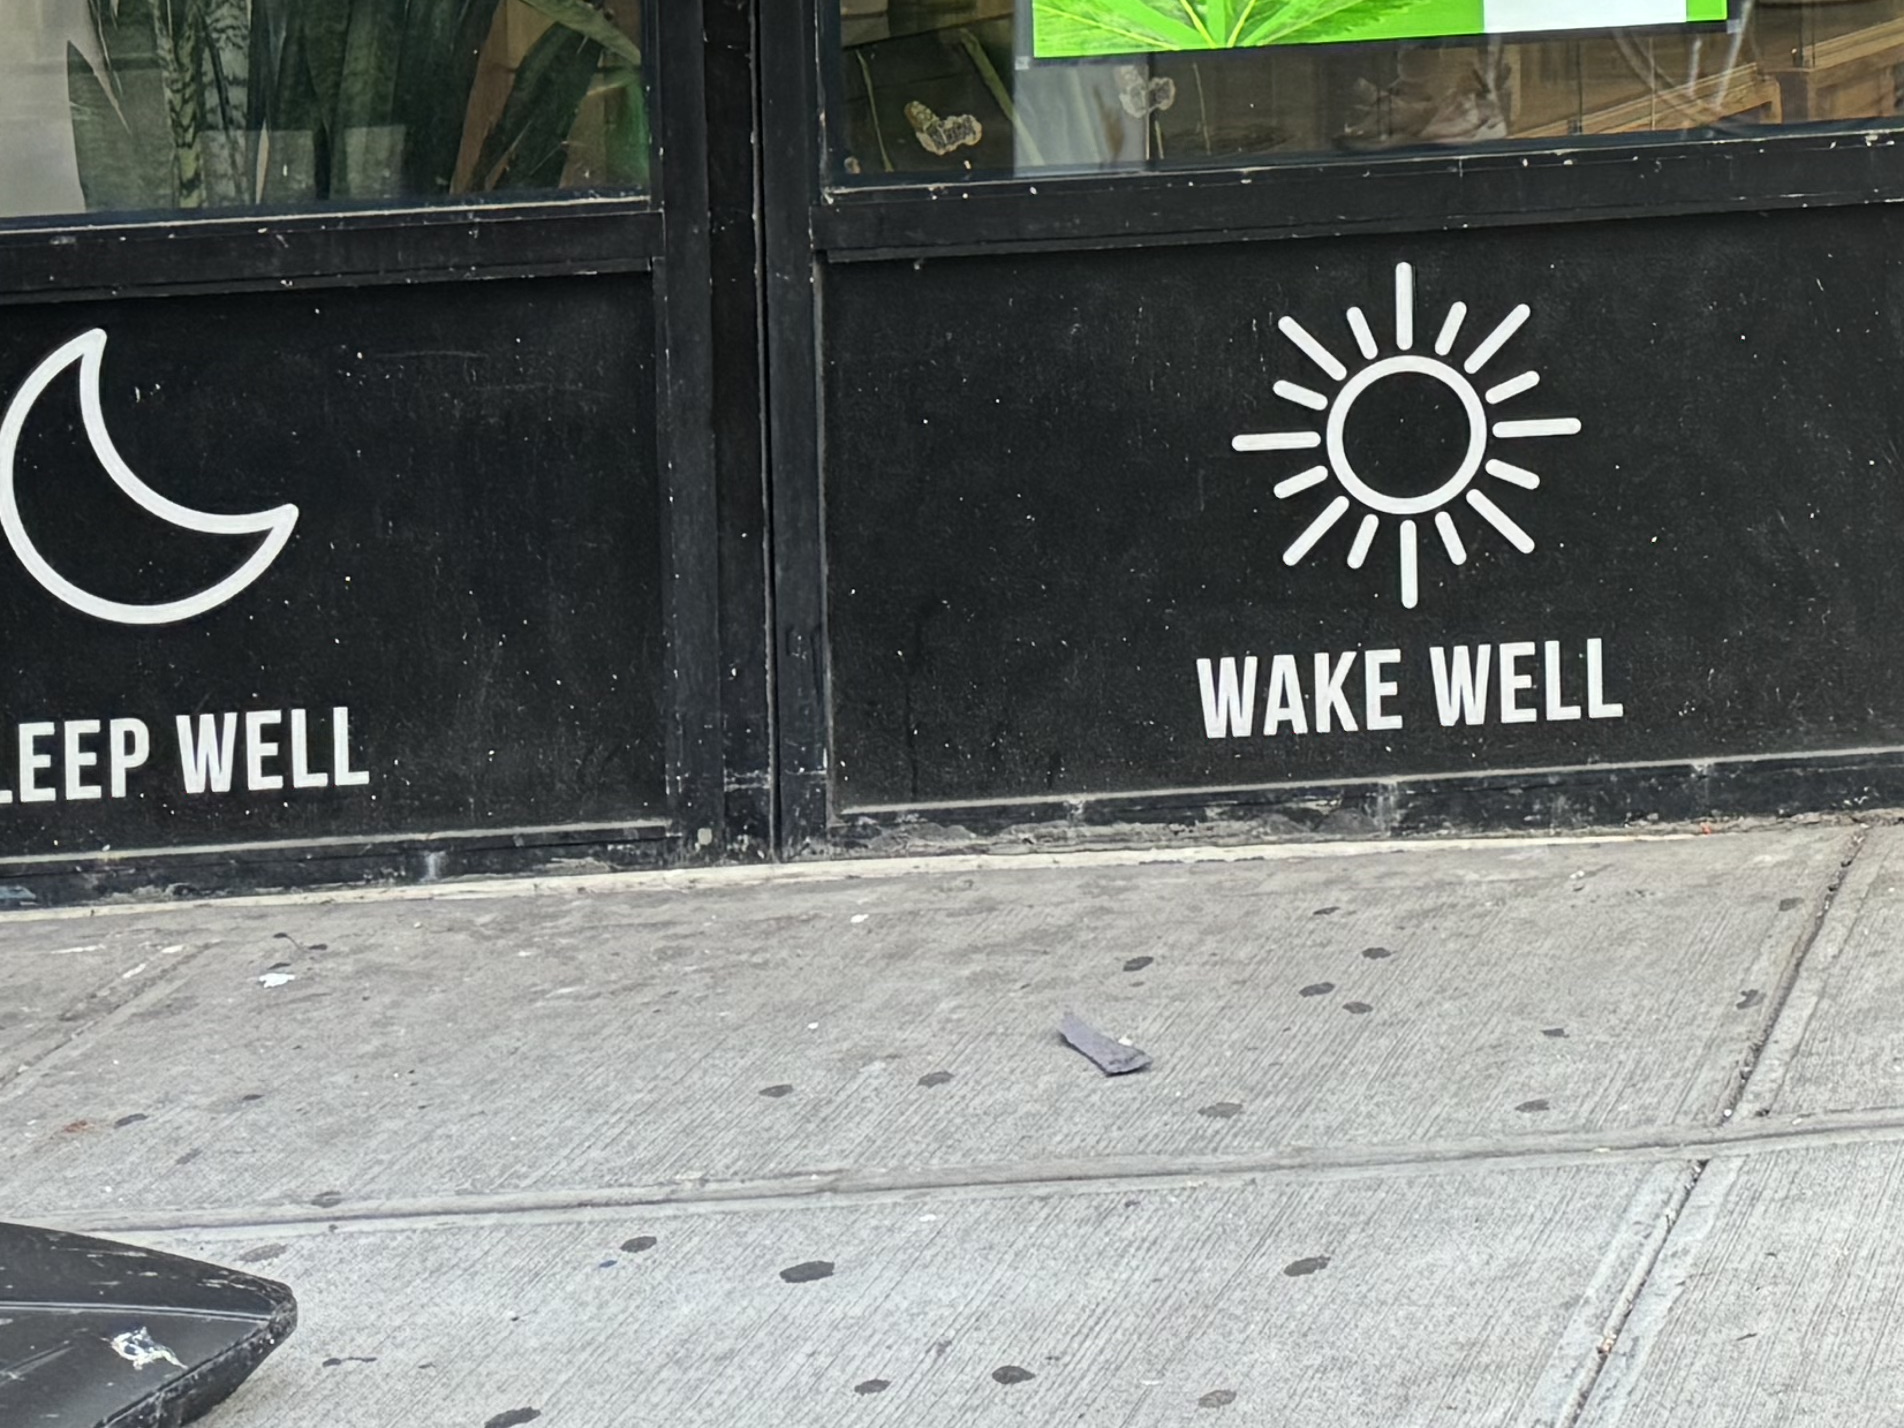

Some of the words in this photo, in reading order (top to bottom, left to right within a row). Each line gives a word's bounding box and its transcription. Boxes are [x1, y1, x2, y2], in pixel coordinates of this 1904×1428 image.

[1196, 649, 1403, 739] WAKE
[1429, 638, 1624, 726] WELL
[0, 717, 151, 804] EEP
[175, 706, 370, 794] WELL
